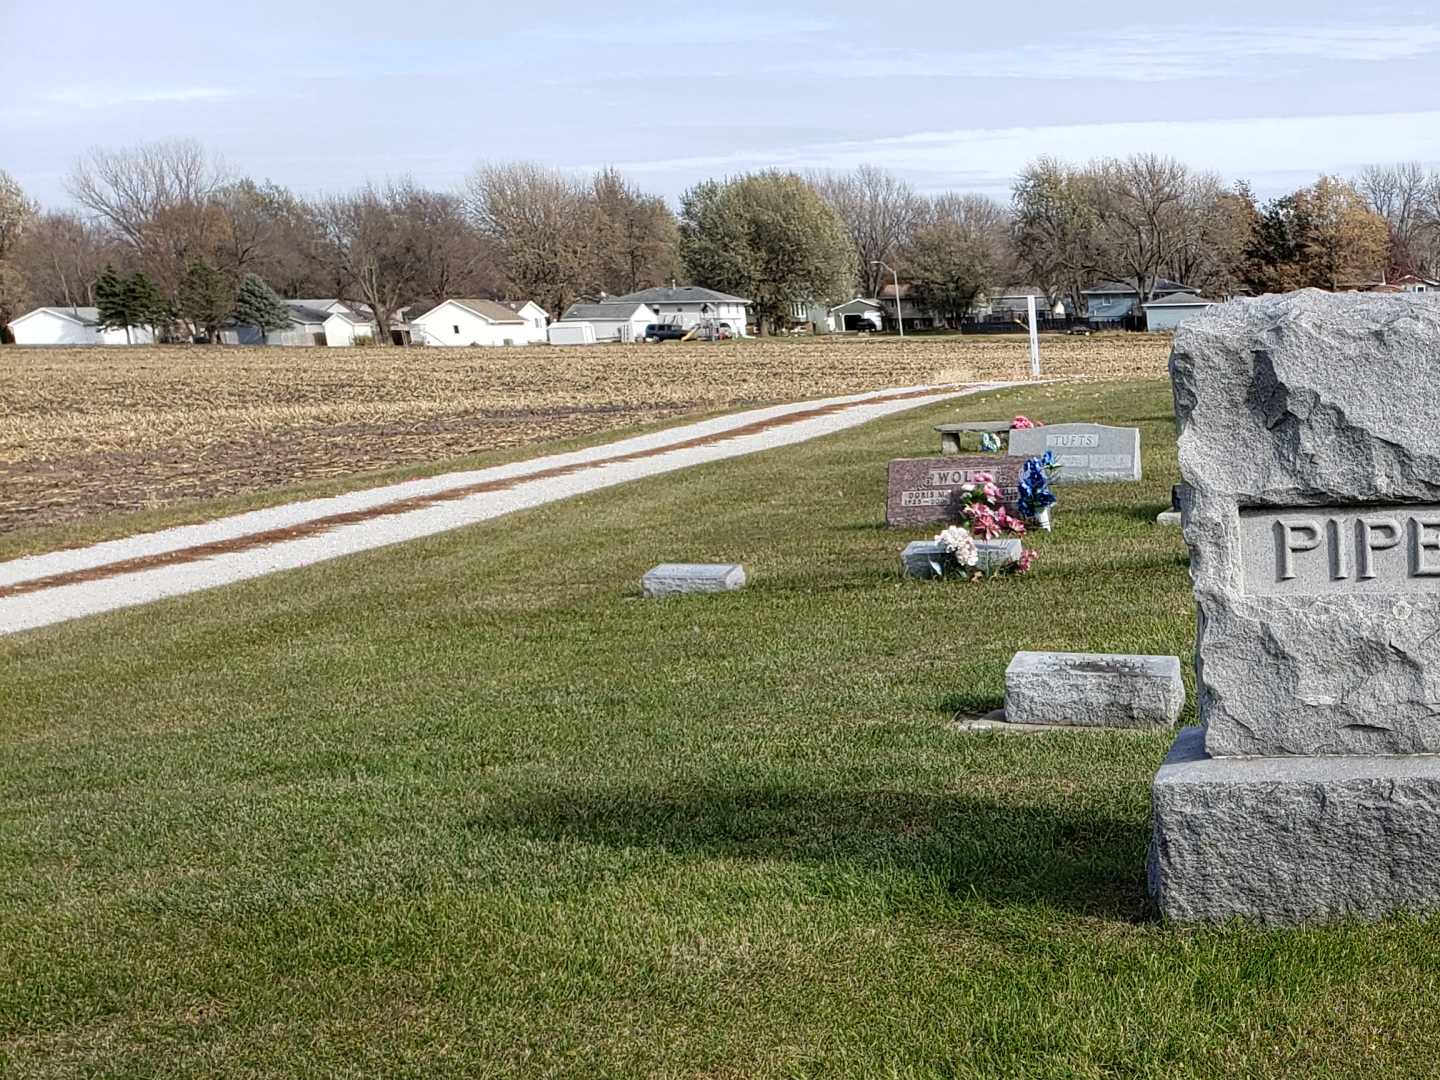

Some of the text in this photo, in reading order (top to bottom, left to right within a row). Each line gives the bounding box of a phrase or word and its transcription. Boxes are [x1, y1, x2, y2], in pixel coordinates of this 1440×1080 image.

[1054, 435, 1093, 446] TUFTS
[937, 470, 993, 483] WOL
[908, 491, 934, 499] DORIS
